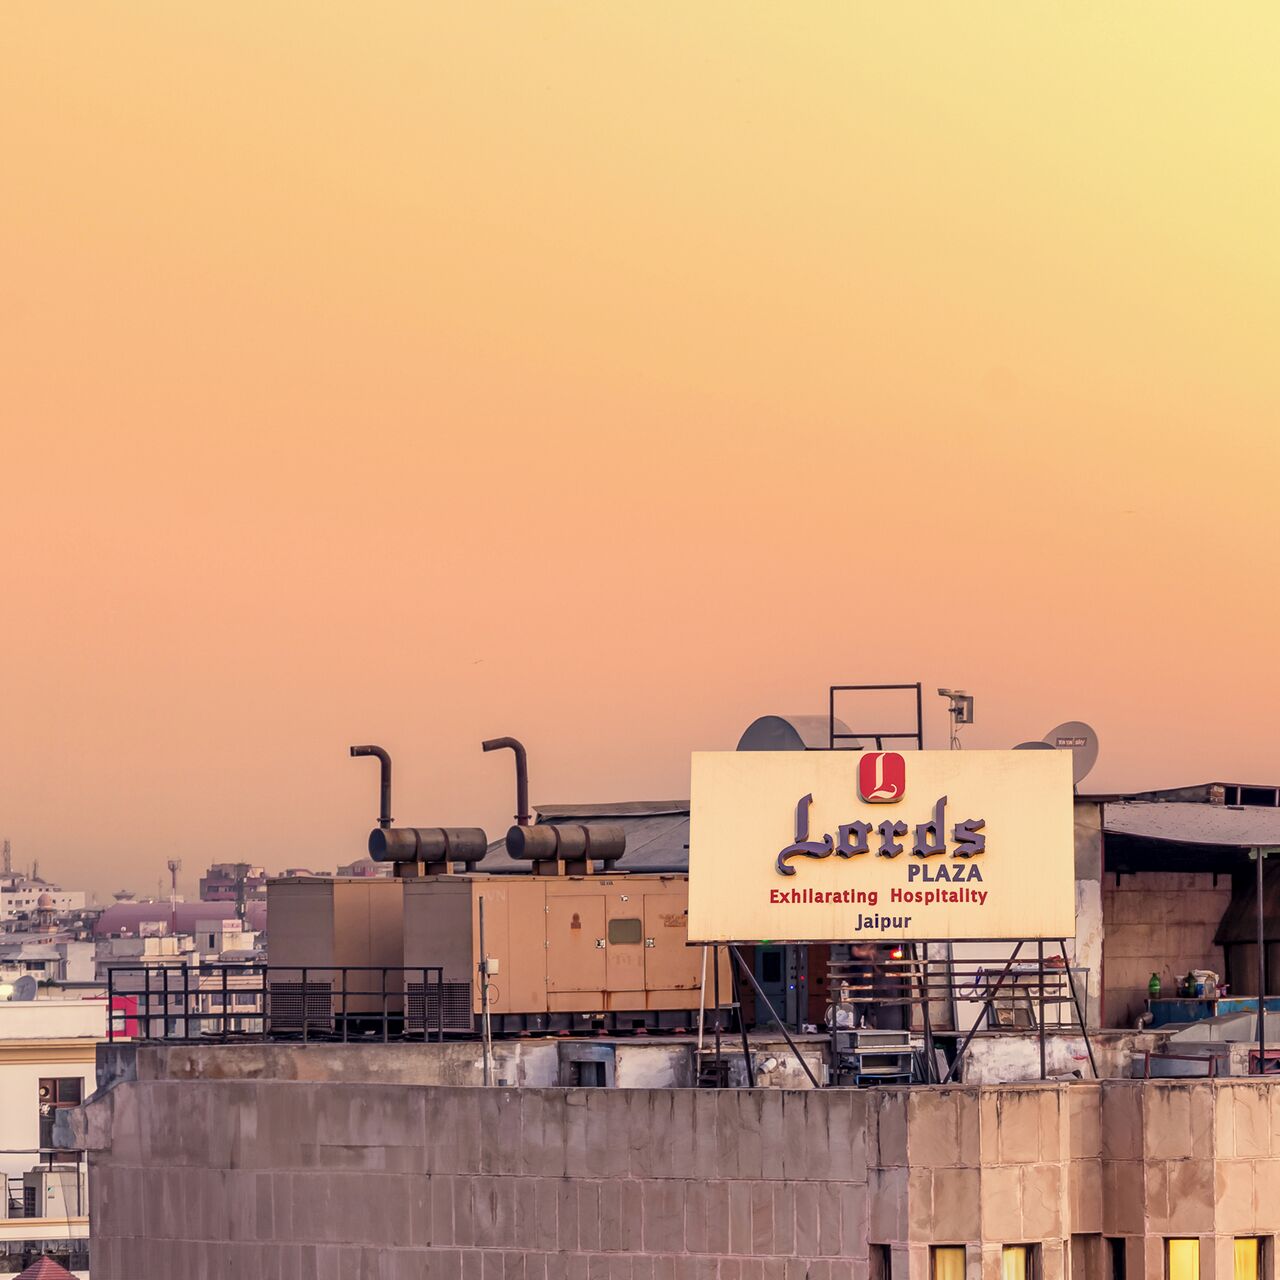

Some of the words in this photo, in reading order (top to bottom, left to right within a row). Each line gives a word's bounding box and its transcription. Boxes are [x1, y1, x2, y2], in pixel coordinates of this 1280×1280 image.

[776, 793, 986, 875] Lords
[908, 864, 983, 882] PLAZA
[770, 889, 878, 906] Exhilarating
[890, 888, 988, 906] Hospitality
[855, 913, 912, 932] Jaipur
